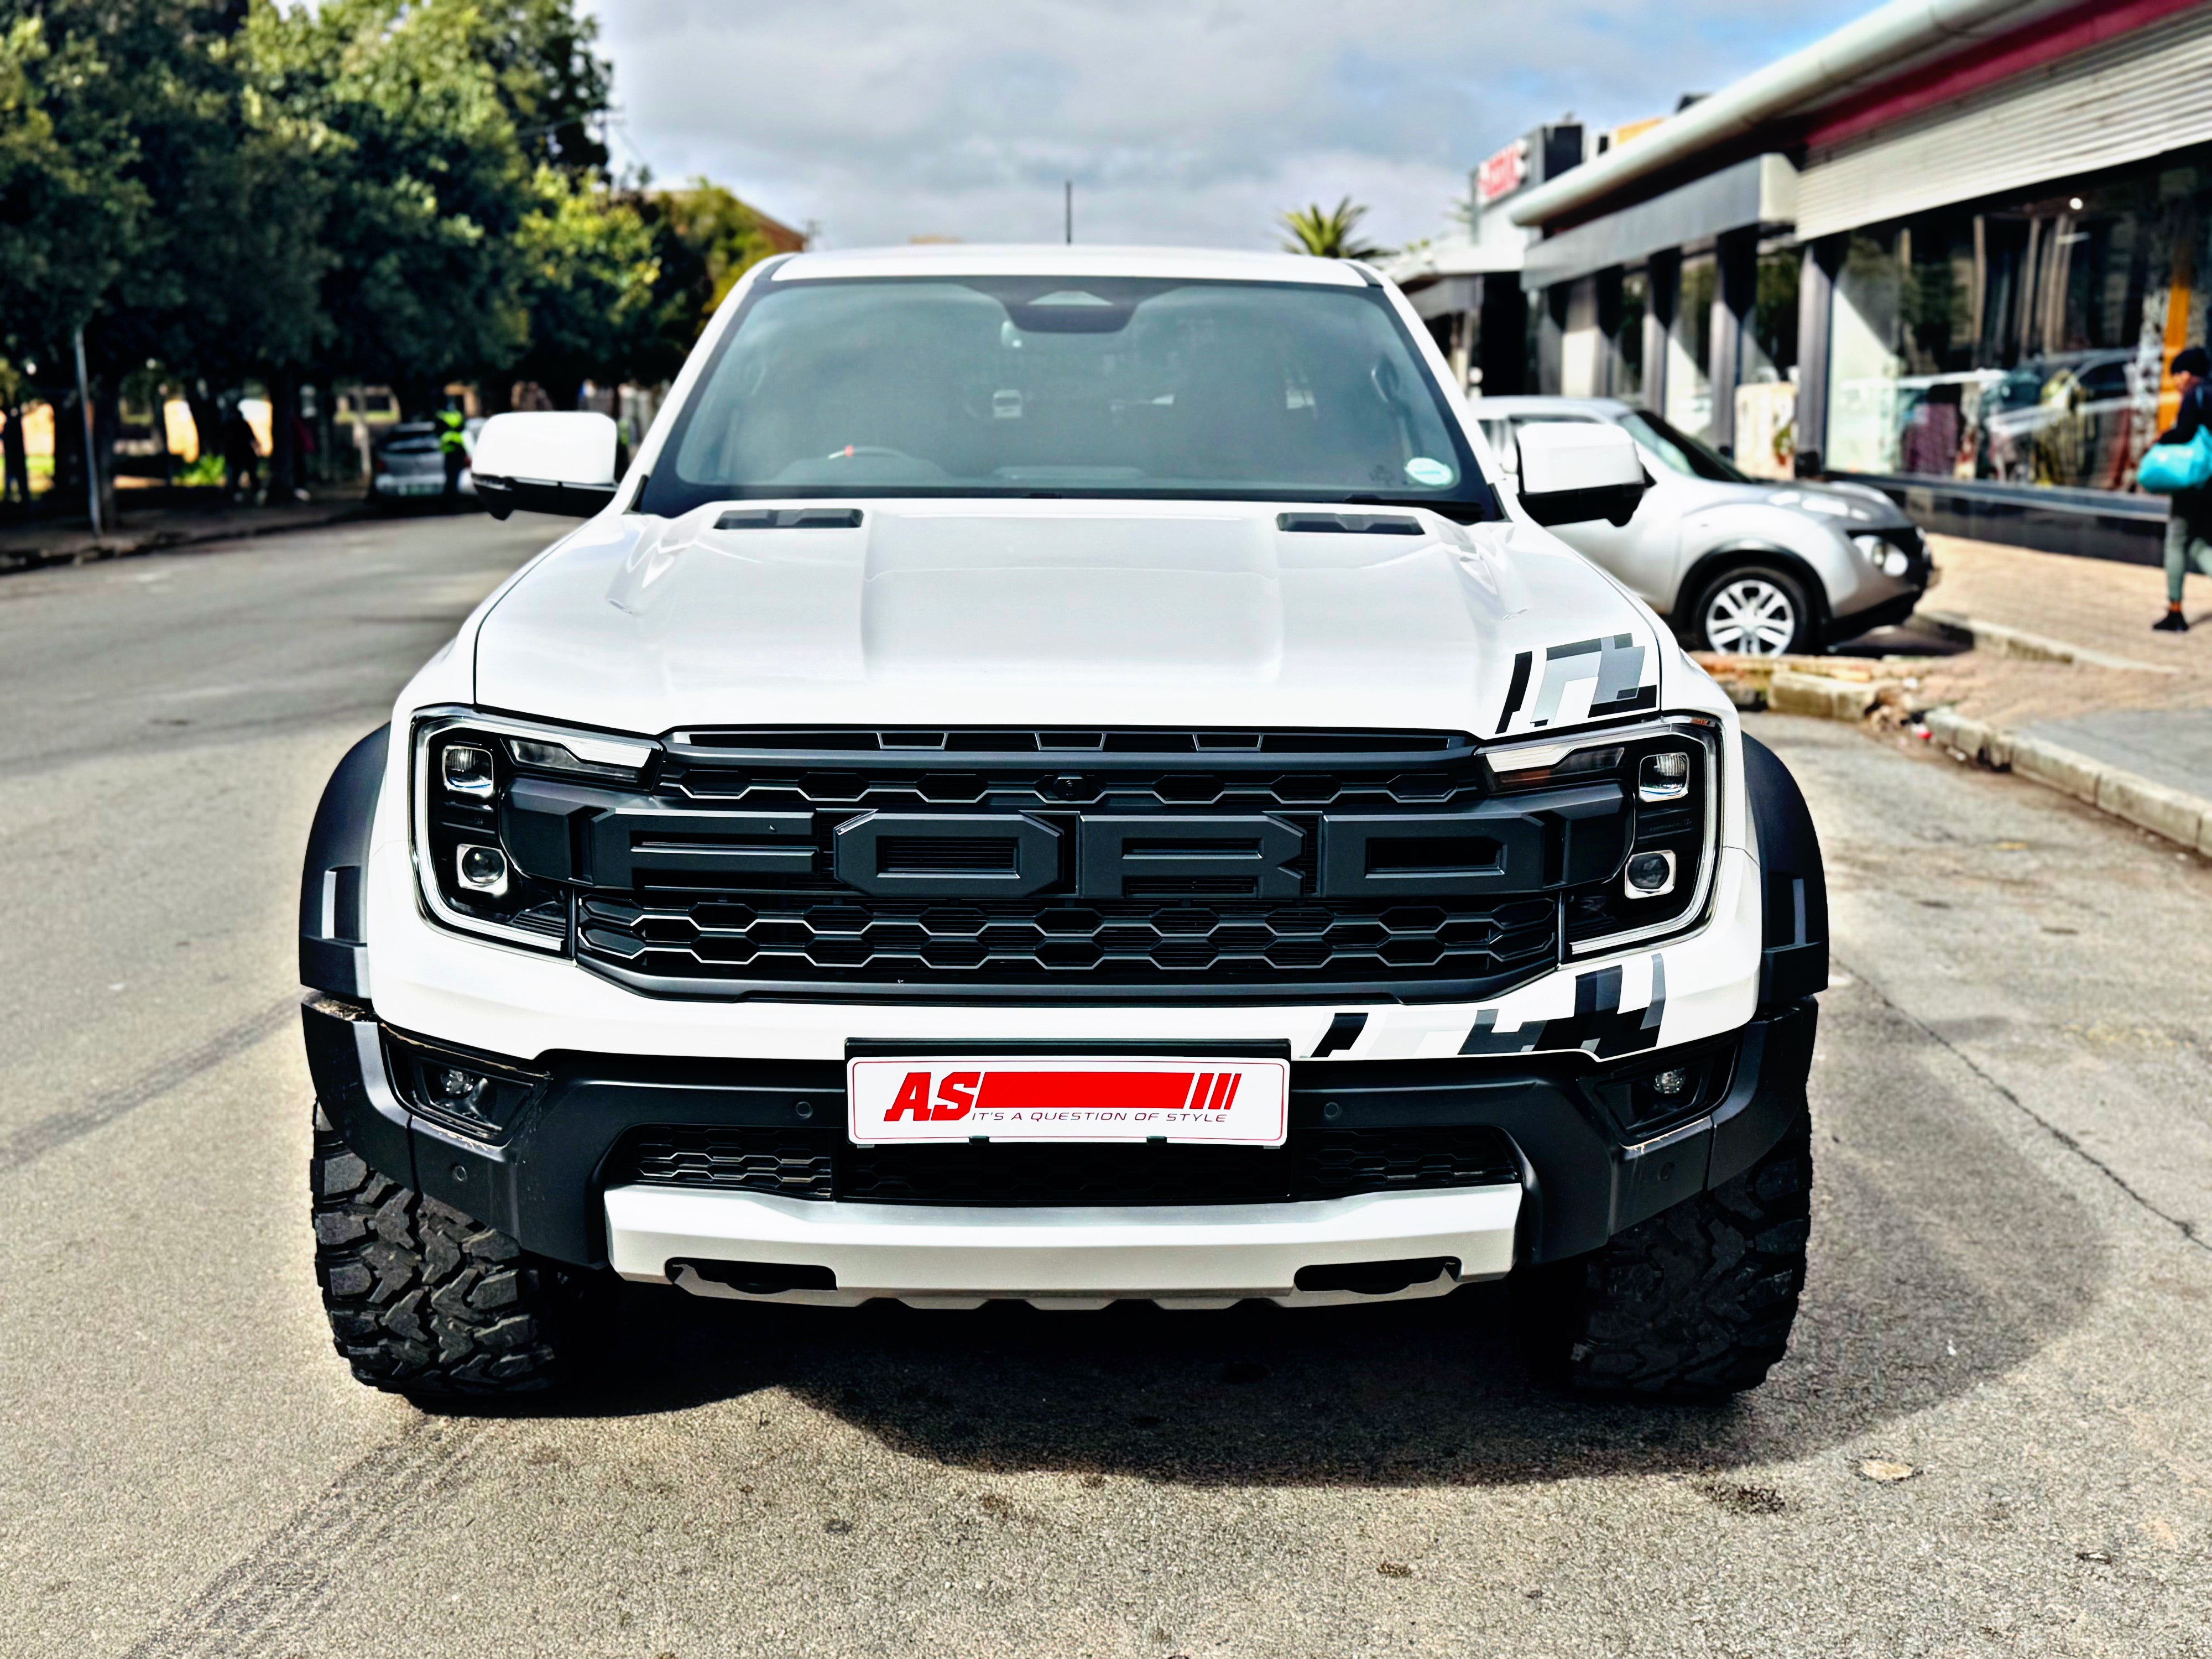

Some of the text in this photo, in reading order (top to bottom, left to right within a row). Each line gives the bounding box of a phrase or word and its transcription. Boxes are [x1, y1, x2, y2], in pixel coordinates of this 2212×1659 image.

[589, 808, 1546, 899] FORD
[883, 1071, 982, 1122] AS
[972, 1112, 1228, 1123] IT'S A QUESTION OF STYLE
